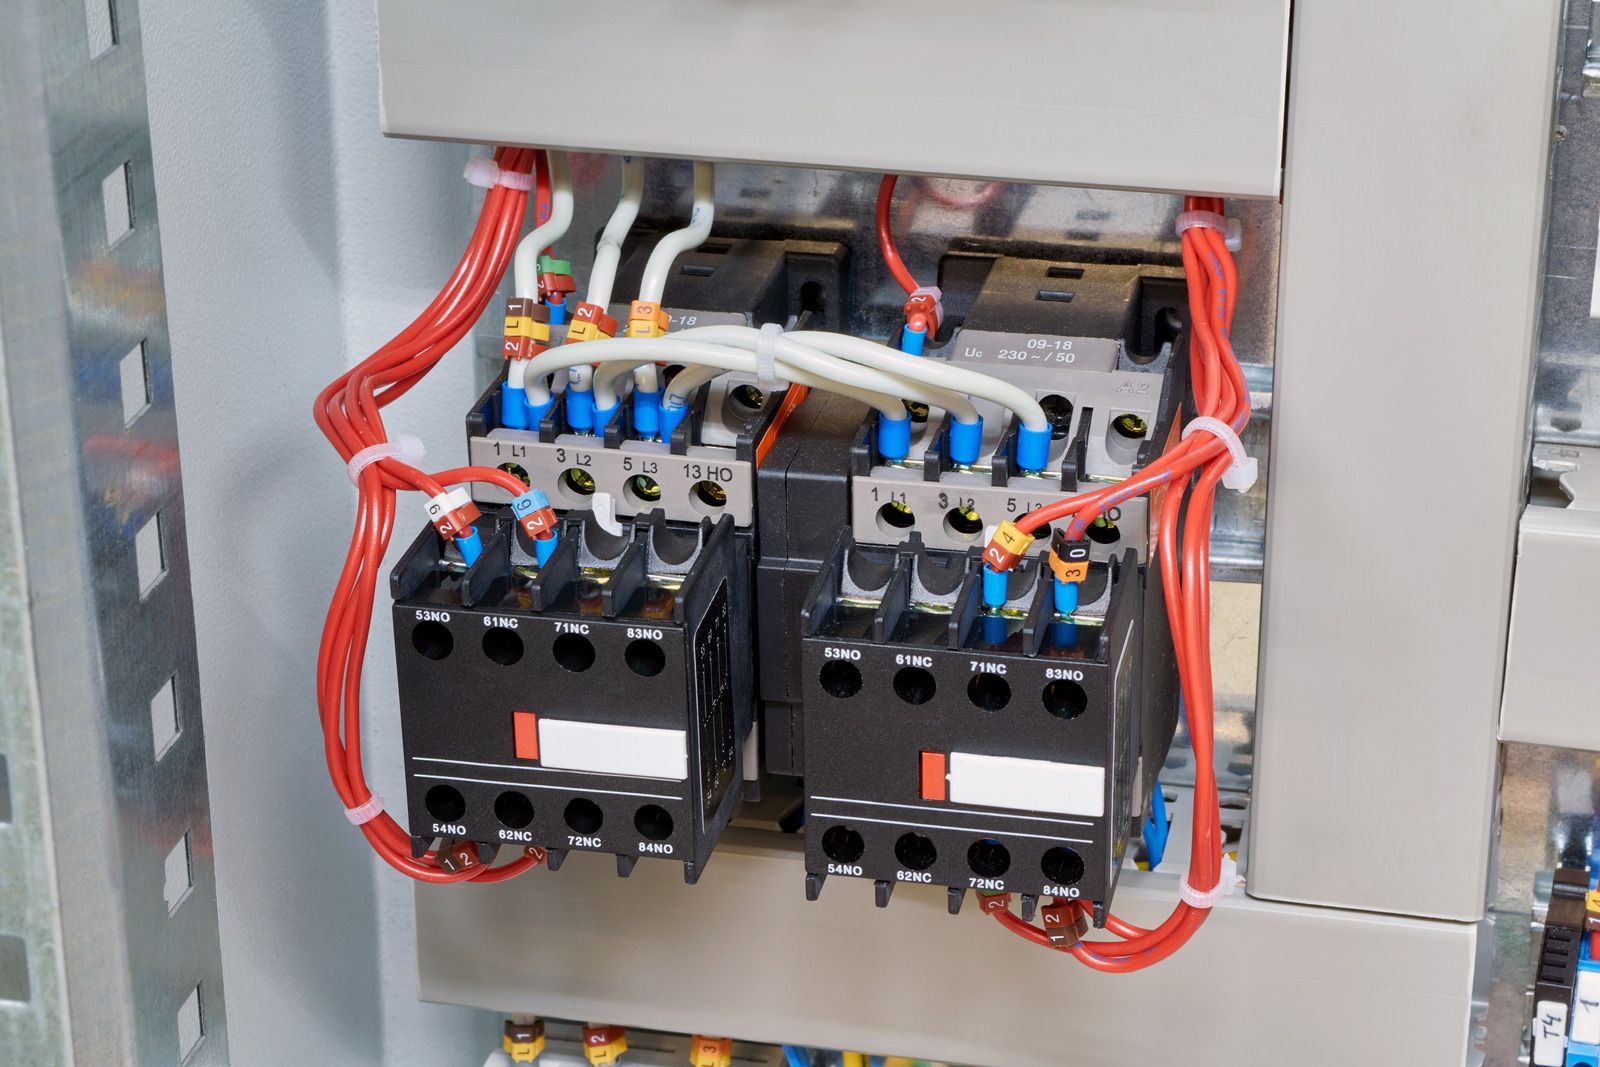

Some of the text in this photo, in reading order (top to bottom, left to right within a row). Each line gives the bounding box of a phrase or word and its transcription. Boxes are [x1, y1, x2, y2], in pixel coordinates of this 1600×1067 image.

[1026, 338, 1073, 351] 09-18
[997, 349, 1028, 362] 230
[511, 444, 527, 458] L1
[556, 448, 592, 467] 3 L2
[622, 457, 658, 475] 5 L3
[683, 463, 702, 479] 13
[938, 492, 949, 509] 3
[1006, 497, 1017, 513] 5
[415, 609, 451, 623] 53NO
[483, 616, 518, 629] 61NC
[554, 621, 590, 636] 71NC
[626, 627, 663, 641] 83NO
[823, 646, 861, 661] 53NO
[895, 654, 933, 668] 61NC
[969, 661, 1007, 675] 71NC
[1045, 668, 1084, 682] 83NO
[432, 822, 466, 836] 54NO
[498, 829, 533, 842] 62NC
[567, 835, 602, 848] 72NC
[638, 841, 673, 854] 84NO
[827, 863, 863, 876] 54NO
[896, 870, 932, 884] 62NC
[968, 877, 1005, 891] 72NC
[1042, 884, 1080, 898] 84NO
